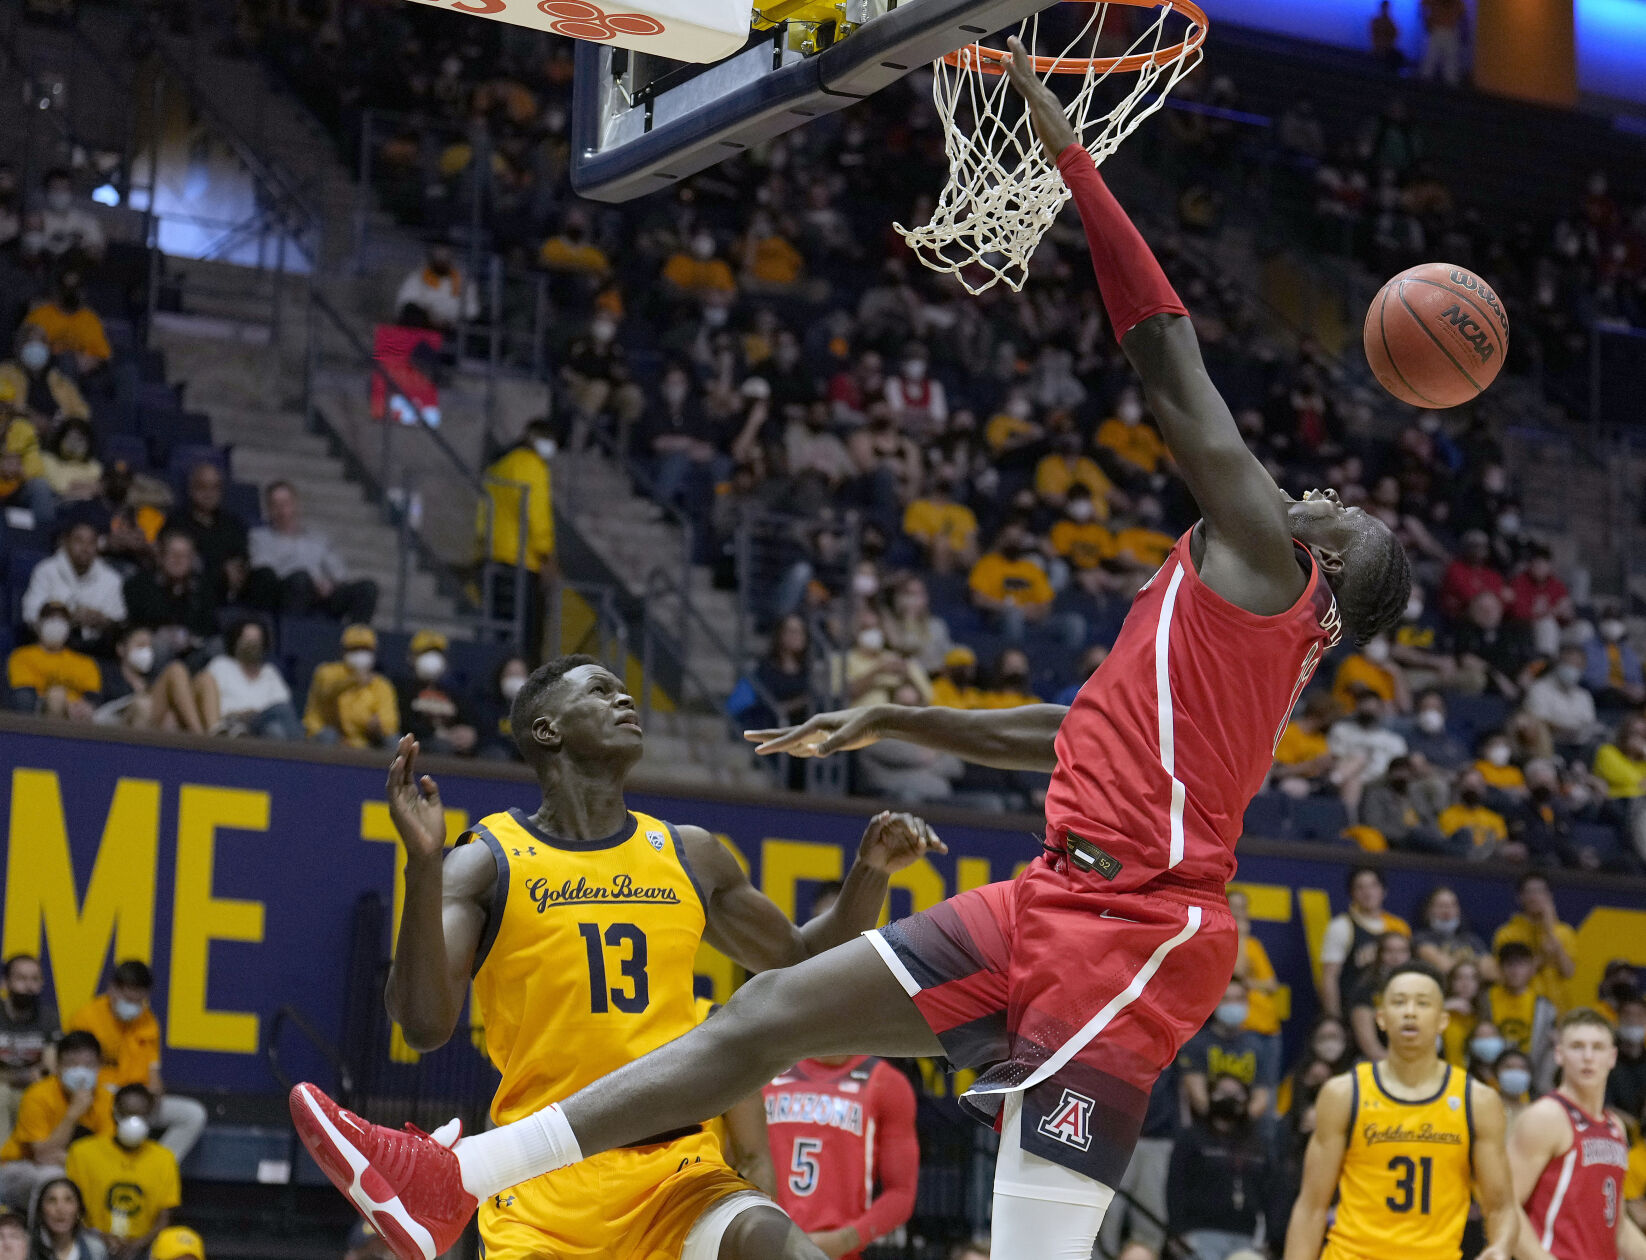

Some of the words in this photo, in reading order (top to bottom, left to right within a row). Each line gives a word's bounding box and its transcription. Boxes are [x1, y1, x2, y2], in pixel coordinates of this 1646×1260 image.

[1441, 303, 1495, 364] NCAA
[525, 877, 610, 914] Golden
[611, 874, 681, 904] Bears
[1099, 858, 1111, 871] 52
[578, 922, 650, 1014] 13
[1037, 1087, 1096, 1152] A
[788, 1136, 823, 1197] 5
[1386, 1155, 1433, 1215] 31
